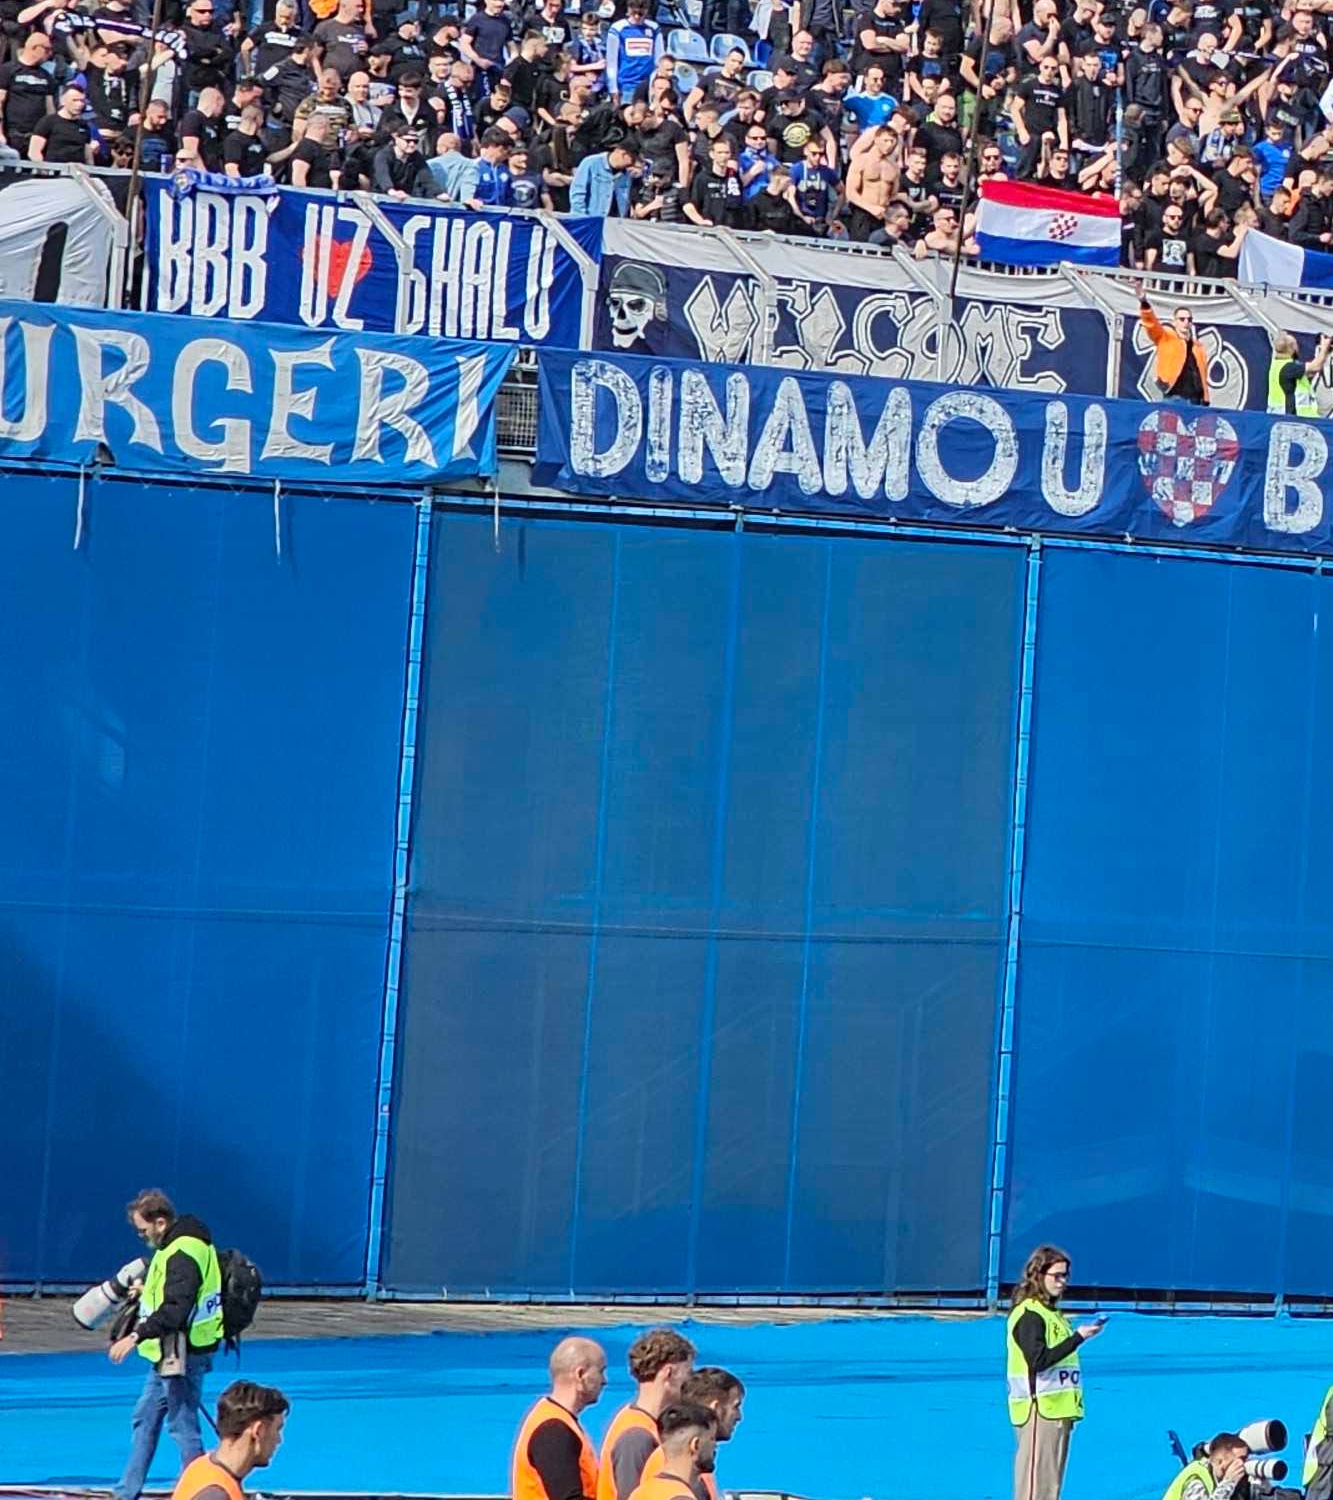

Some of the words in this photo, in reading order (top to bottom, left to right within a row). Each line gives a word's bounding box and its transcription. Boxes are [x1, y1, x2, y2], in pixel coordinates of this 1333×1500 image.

[156, 188, 277, 320] BBB
[299, 202, 373, 332] UZ
[569, 358, 1020, 510] DINAMO
[1040, 400, 1108, 518] U
